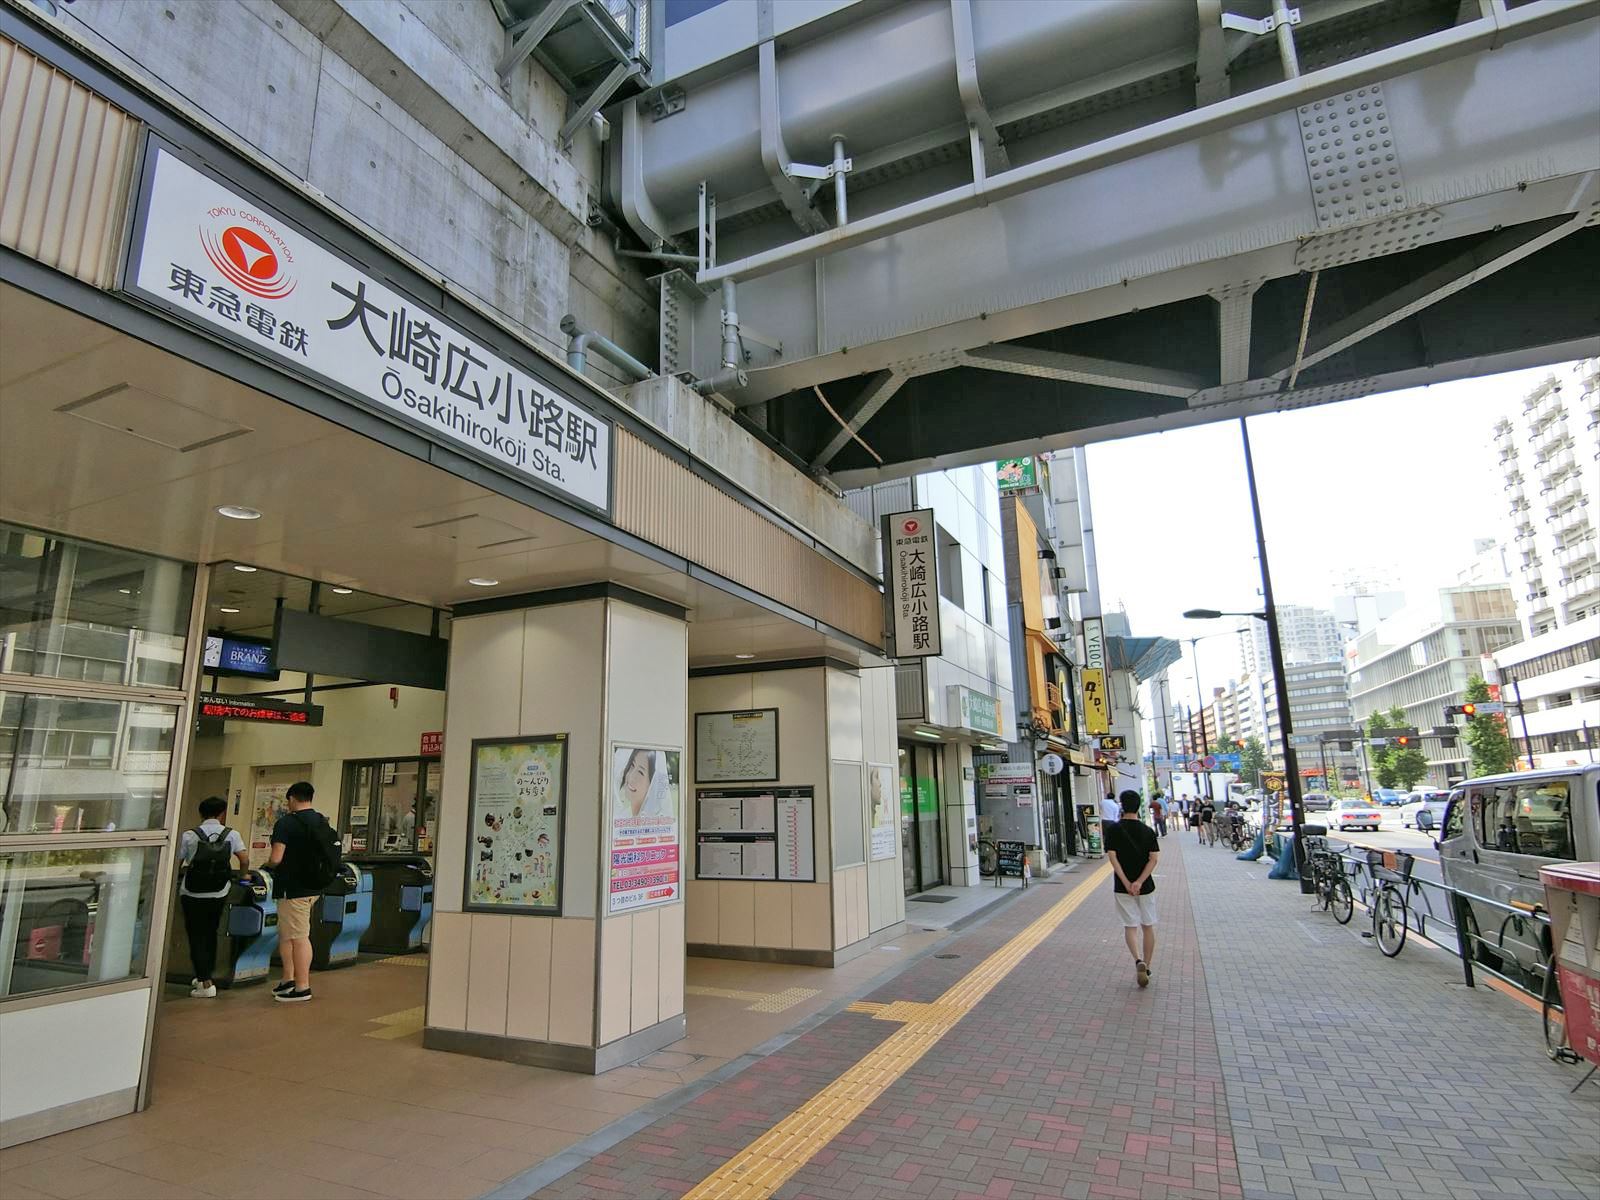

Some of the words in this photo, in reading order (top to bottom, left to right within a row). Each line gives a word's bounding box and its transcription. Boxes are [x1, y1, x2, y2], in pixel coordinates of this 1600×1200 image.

[207, 207, 237, 219] TOKYU
[239, 210, 294, 264] CORPORATION
[167, 261, 310, 359] 東急電鉄
[326, 280, 598, 471] 大崎広小路駅
[532, 448, 566, 483] Sta.
[895, 535, 928, 546] 東急電鉄
[908, 548, 930, 650] 大崎広小路駅
[230, 650, 268, 665] BRANZ
[1088, 635, 1102, 668] VELOC
[612, 881, 625, 890] TEL
